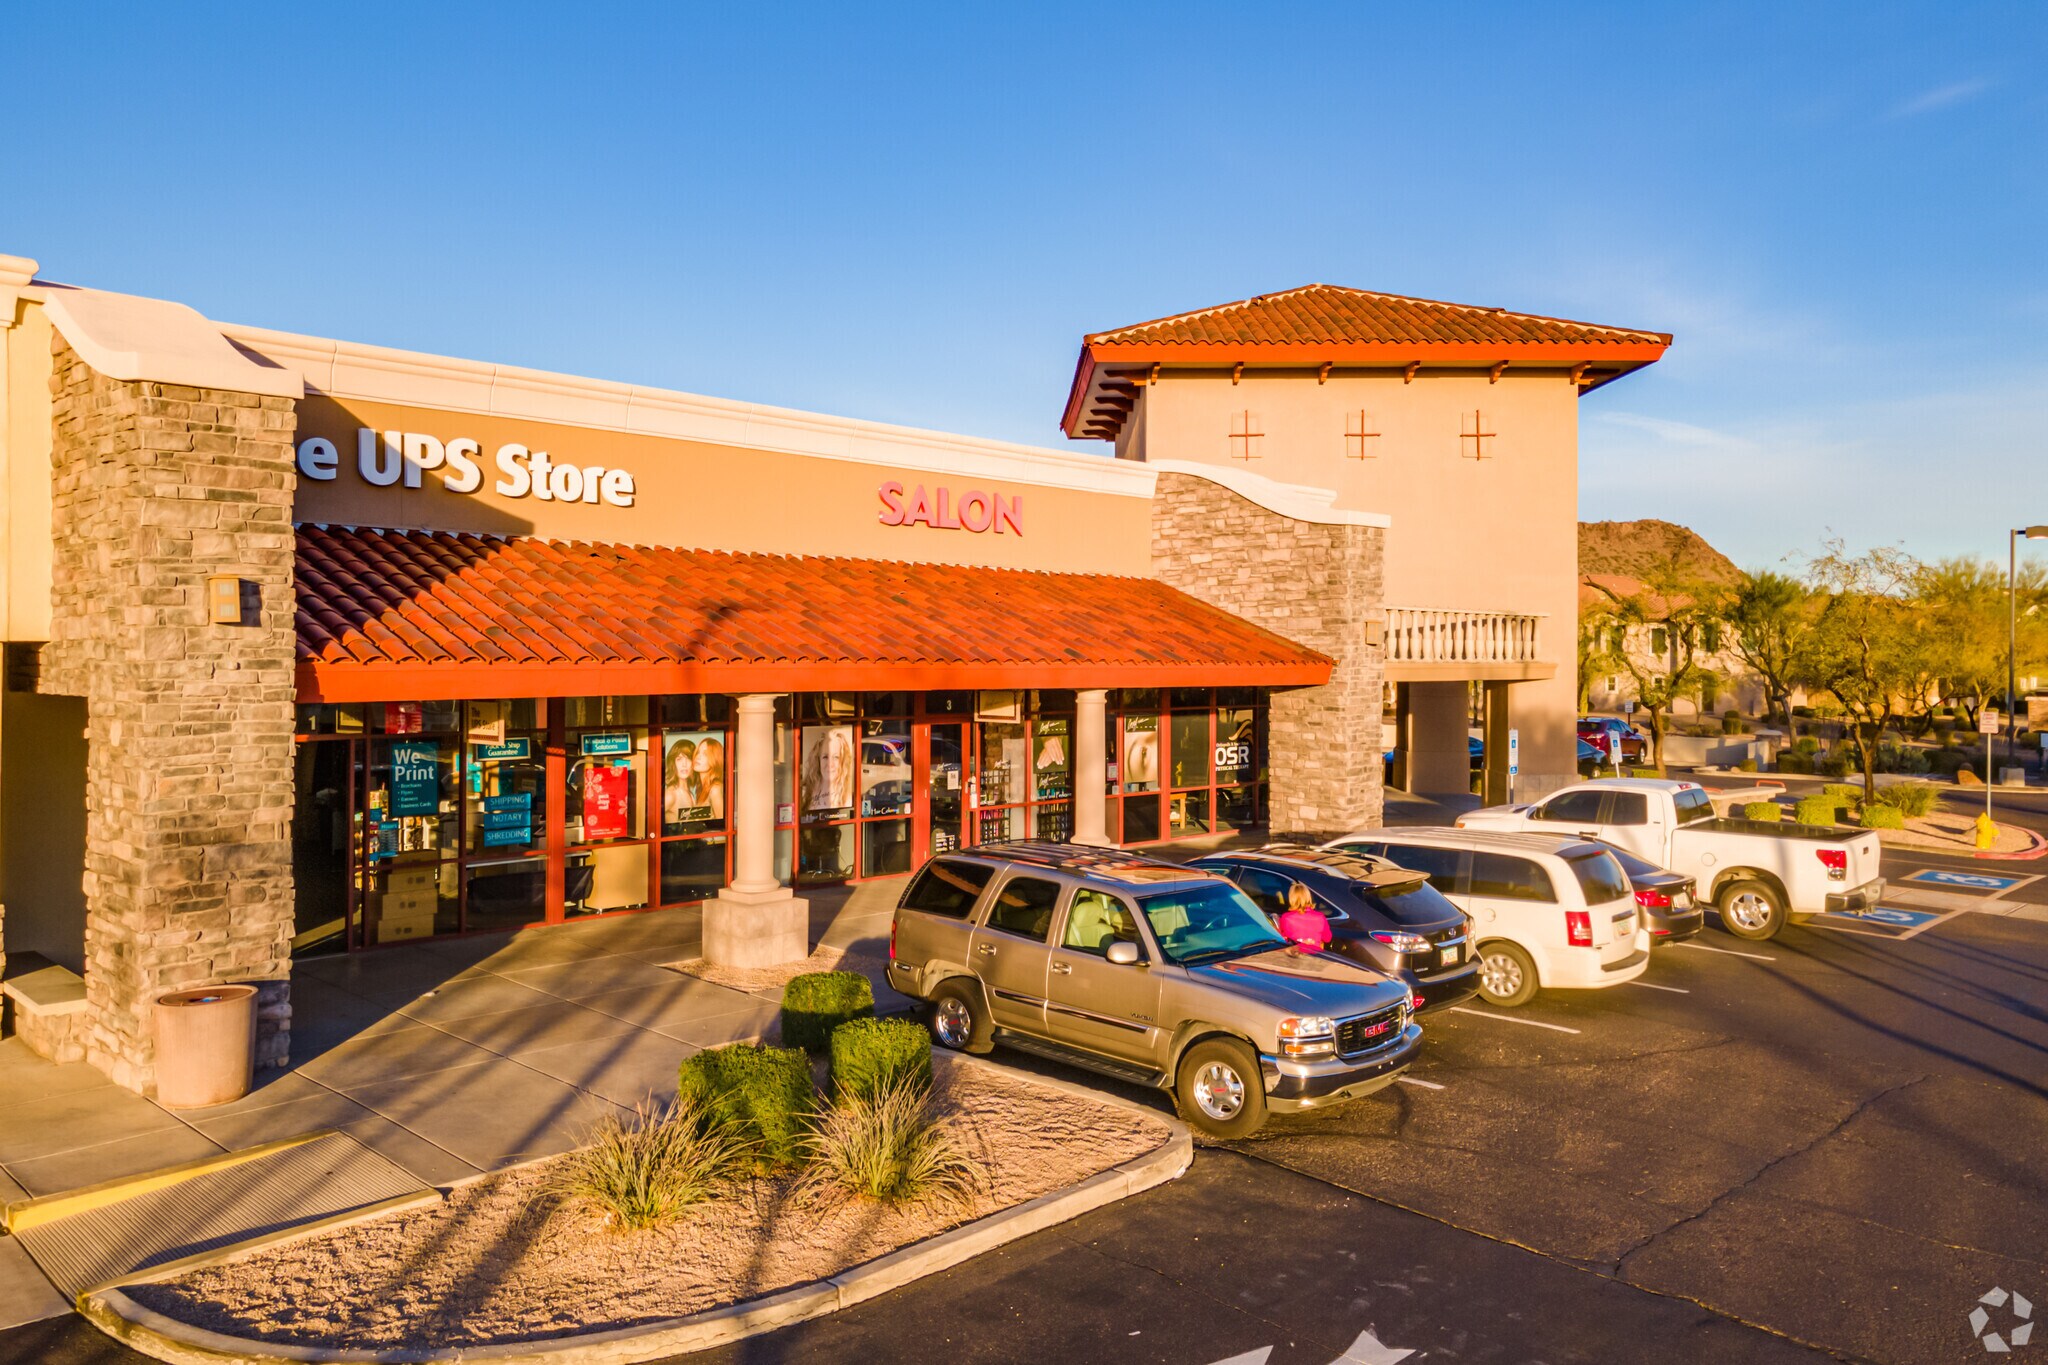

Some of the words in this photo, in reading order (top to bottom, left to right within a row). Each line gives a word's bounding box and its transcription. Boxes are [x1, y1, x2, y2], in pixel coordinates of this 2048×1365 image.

[358, 428, 483, 493] UPS
[496, 443, 634, 506] Store
[879, 481, 1023, 537] SALON
[946, 700, 953, 711] 3
[308, 715, 317, 731] 1
[394, 748, 421, 765] We
[487, 749, 519, 757] Guarantee
[1215, 746, 1249, 766] OSR
[395, 765, 434, 782] Print
[490, 795, 525, 806] SHIPPING
[492, 813, 523, 823] NOTARY
[486, 830, 528, 841] SHREDDING
[1365, 1020, 1390, 1038] GMC
